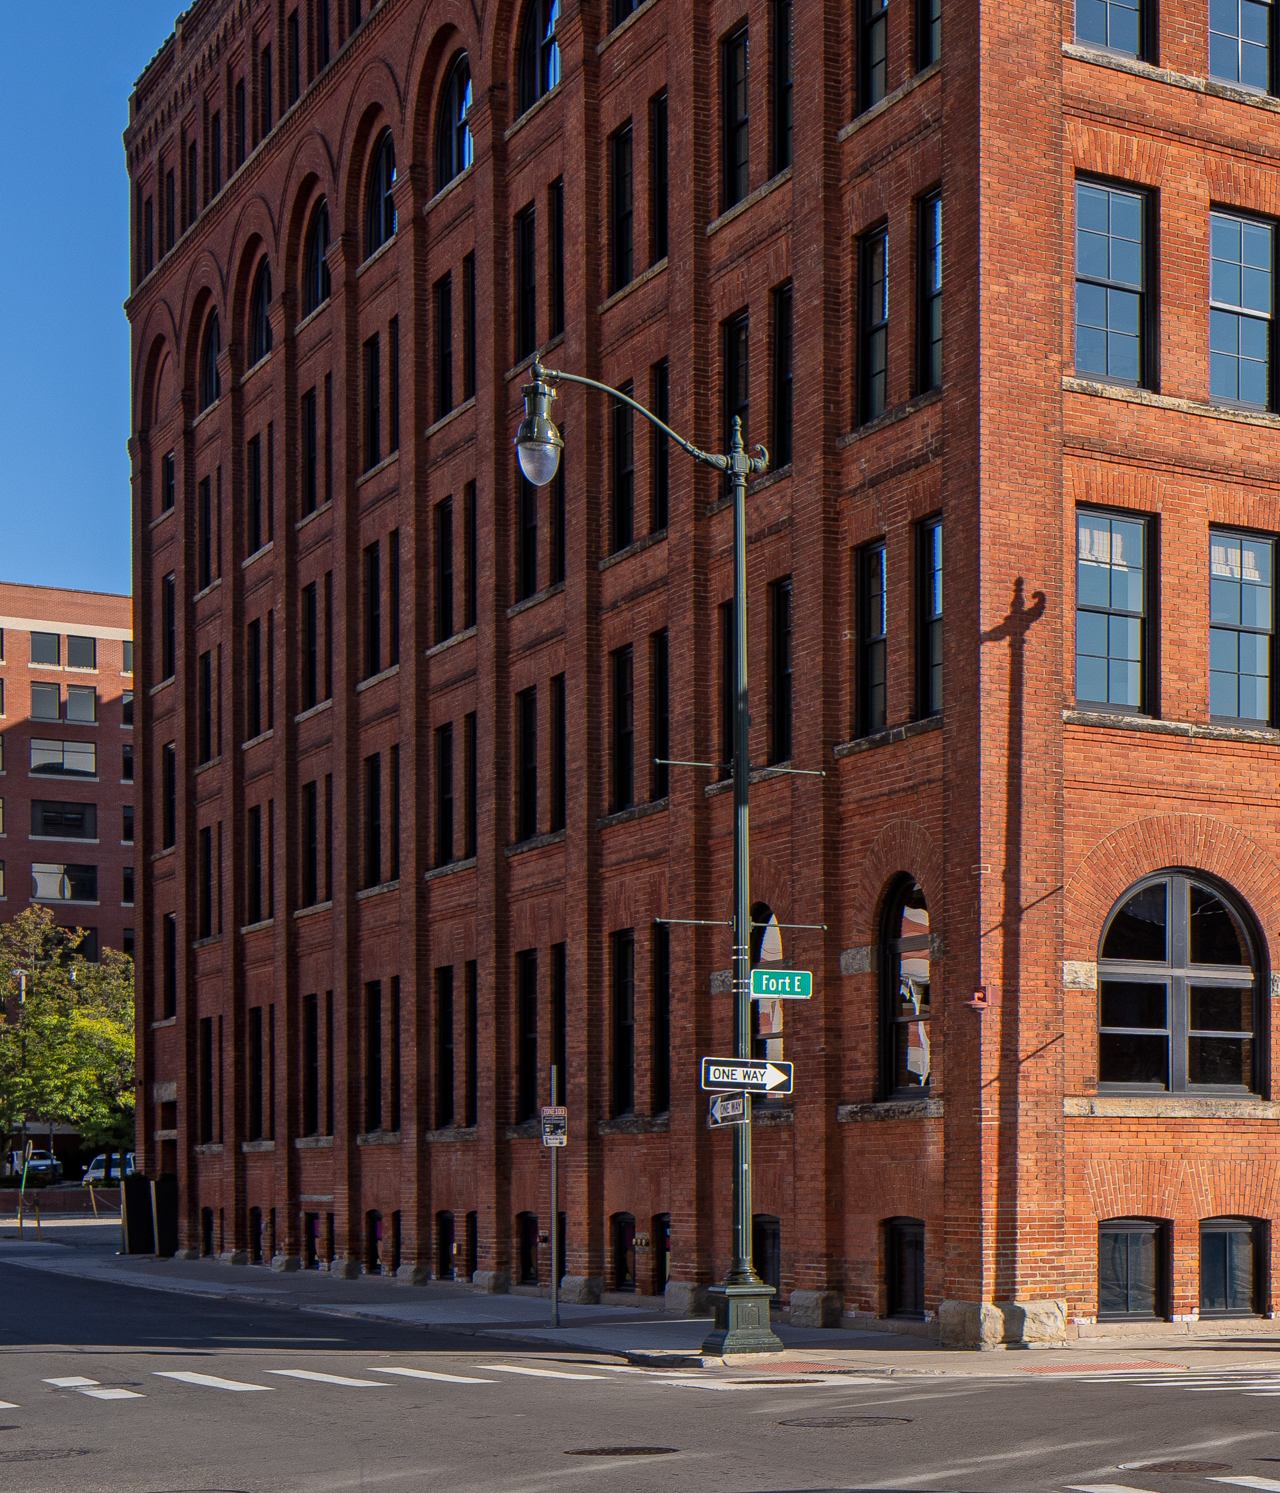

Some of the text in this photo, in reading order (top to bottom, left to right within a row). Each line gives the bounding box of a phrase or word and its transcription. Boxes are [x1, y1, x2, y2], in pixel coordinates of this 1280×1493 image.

[761, 974, 802, 992] Fort E
[713, 1068, 766, 1082] ONE WAY
[719, 1099, 742, 1115] ONE WAY
